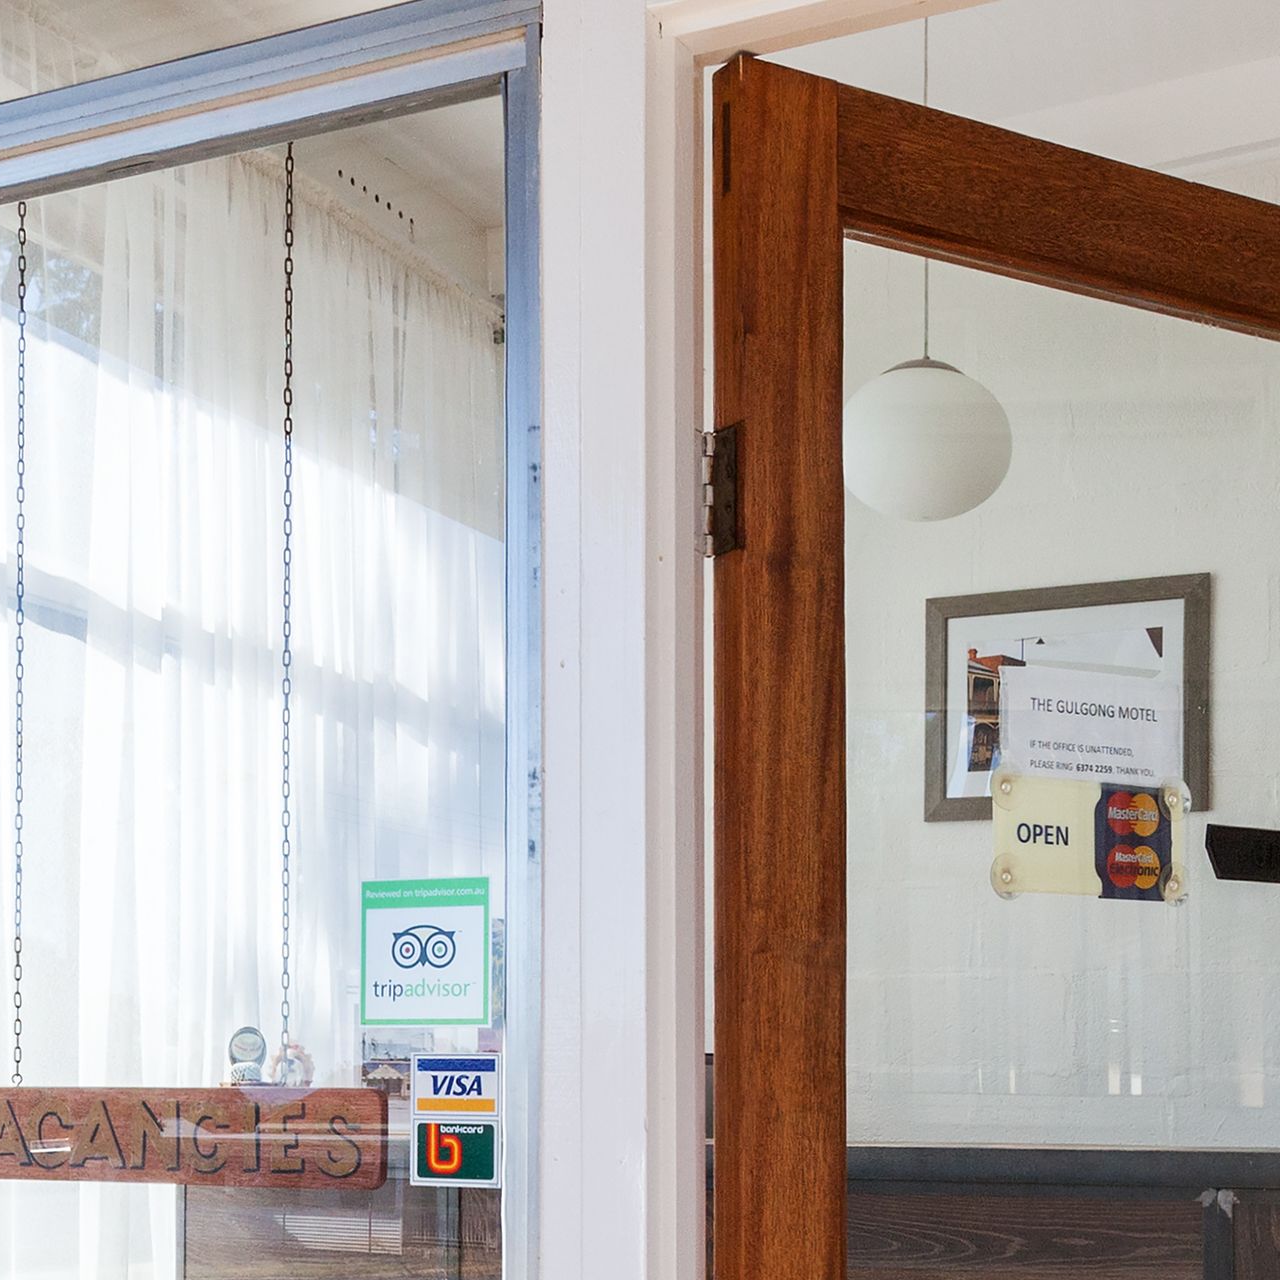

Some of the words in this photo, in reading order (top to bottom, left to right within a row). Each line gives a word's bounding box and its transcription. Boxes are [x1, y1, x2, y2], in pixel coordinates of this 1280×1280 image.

[1031, 697, 1053, 713] THE
[1056, 700, 1115, 718] GULGONG
[1118, 706, 1158, 722] MOTEL
[1029, 740, 1036, 749] IF
[1038, 740, 1051, 750] THE
[1052, 742, 1076, 752] OFFICE
[1077, 744, 1085, 753] IS
[1085, 745, 1135, 758] UNATTENDED,
[1030, 759, 1054, 770] PLEASE
[1055, 761, 1073, 771] RING
[1075, 763, 1093, 773] 6374
[1116, 766, 1140, 776] THANK
[1108, 806, 1157, 822] MasterCard
[1017, 822, 1069, 846] OPEN
[1115, 851, 1153, 863] MasterCard
[365, 889, 401, 899] Reviewed
[403, 890, 413, 898] on
[414, 886, 485, 898] tripadvisor.com.au
[373, 978, 471, 1002] tripadvisor
[431, 1074, 482, 1096] VISA
[440, 1125, 484, 1135] bankcard
